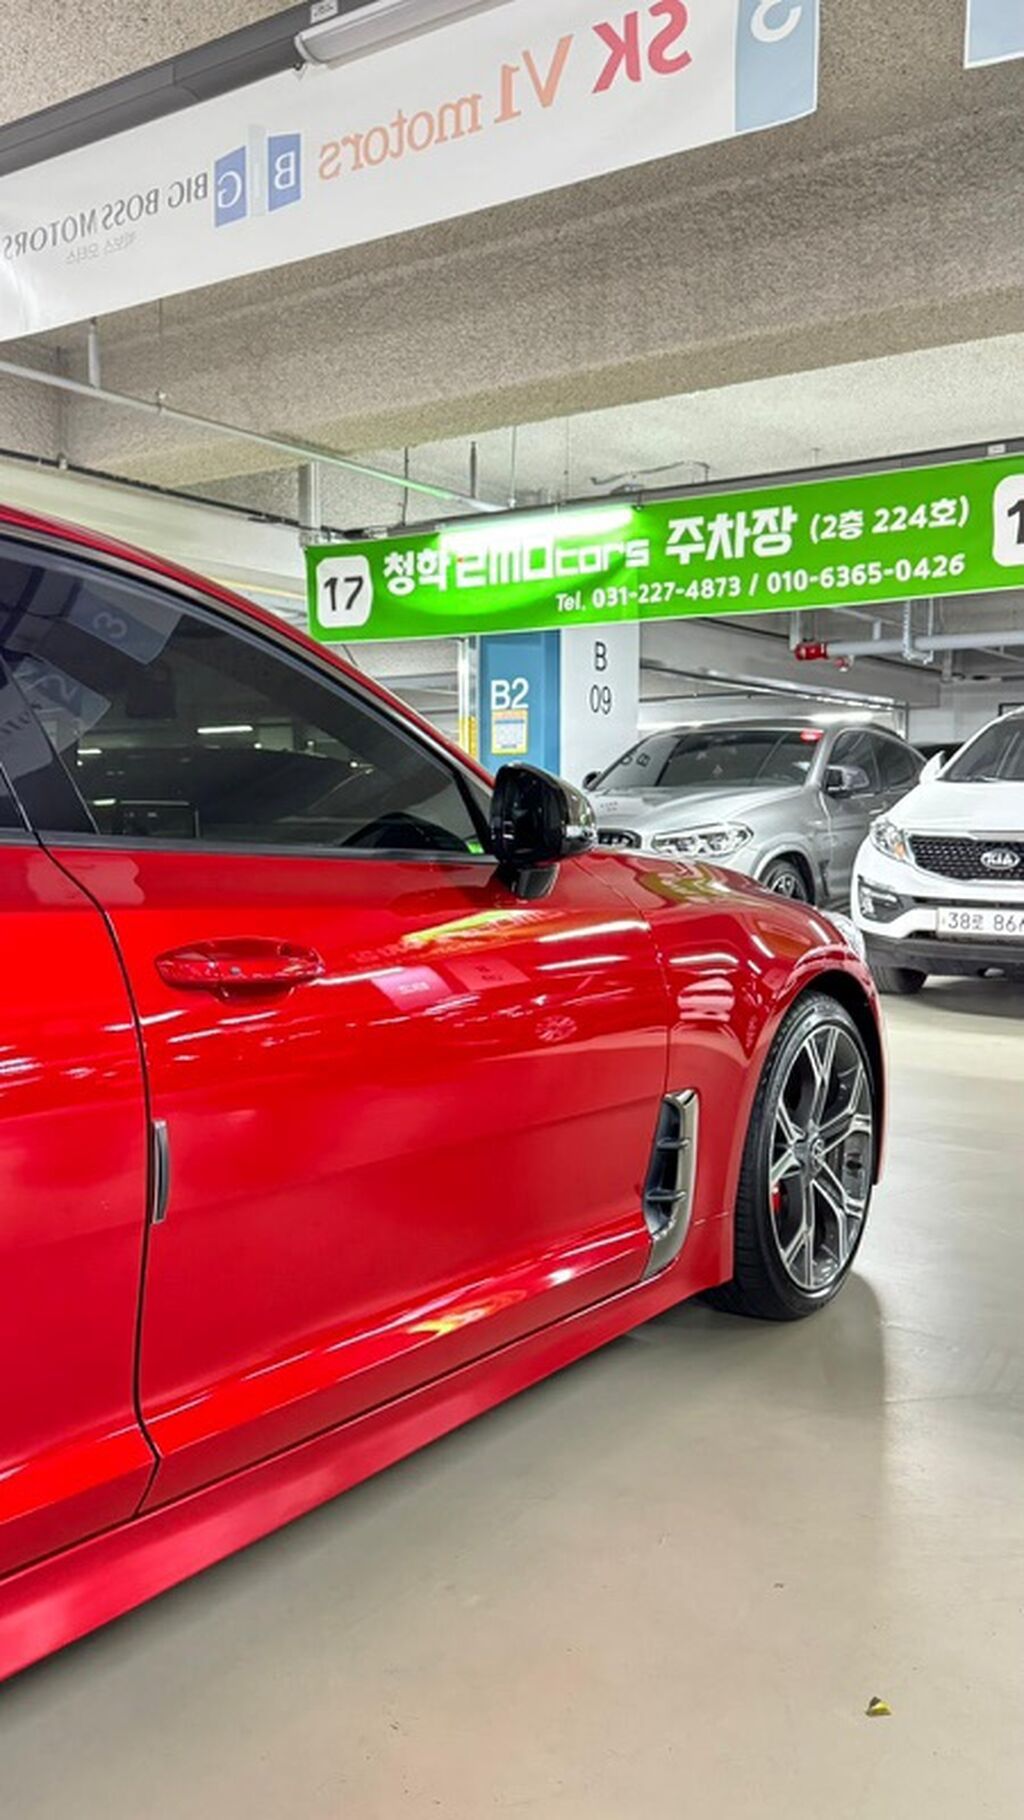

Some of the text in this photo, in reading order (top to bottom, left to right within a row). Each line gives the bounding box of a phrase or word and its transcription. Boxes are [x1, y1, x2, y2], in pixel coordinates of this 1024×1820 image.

[665, 505, 798, 564] 주차장
[810, 509, 864, 544] (2층
[872, 495, 970, 534] 224호)
[322, 576, 364, 612] 17
[555, 553, 966, 612] Tel. 031-227-4873 / 010-6365-0426
[594, 641, 608, 672] B
[490, 677, 529, 709] B2
[589, 684, 613, 715] 09
[985, 850, 1015, 867] KIA
